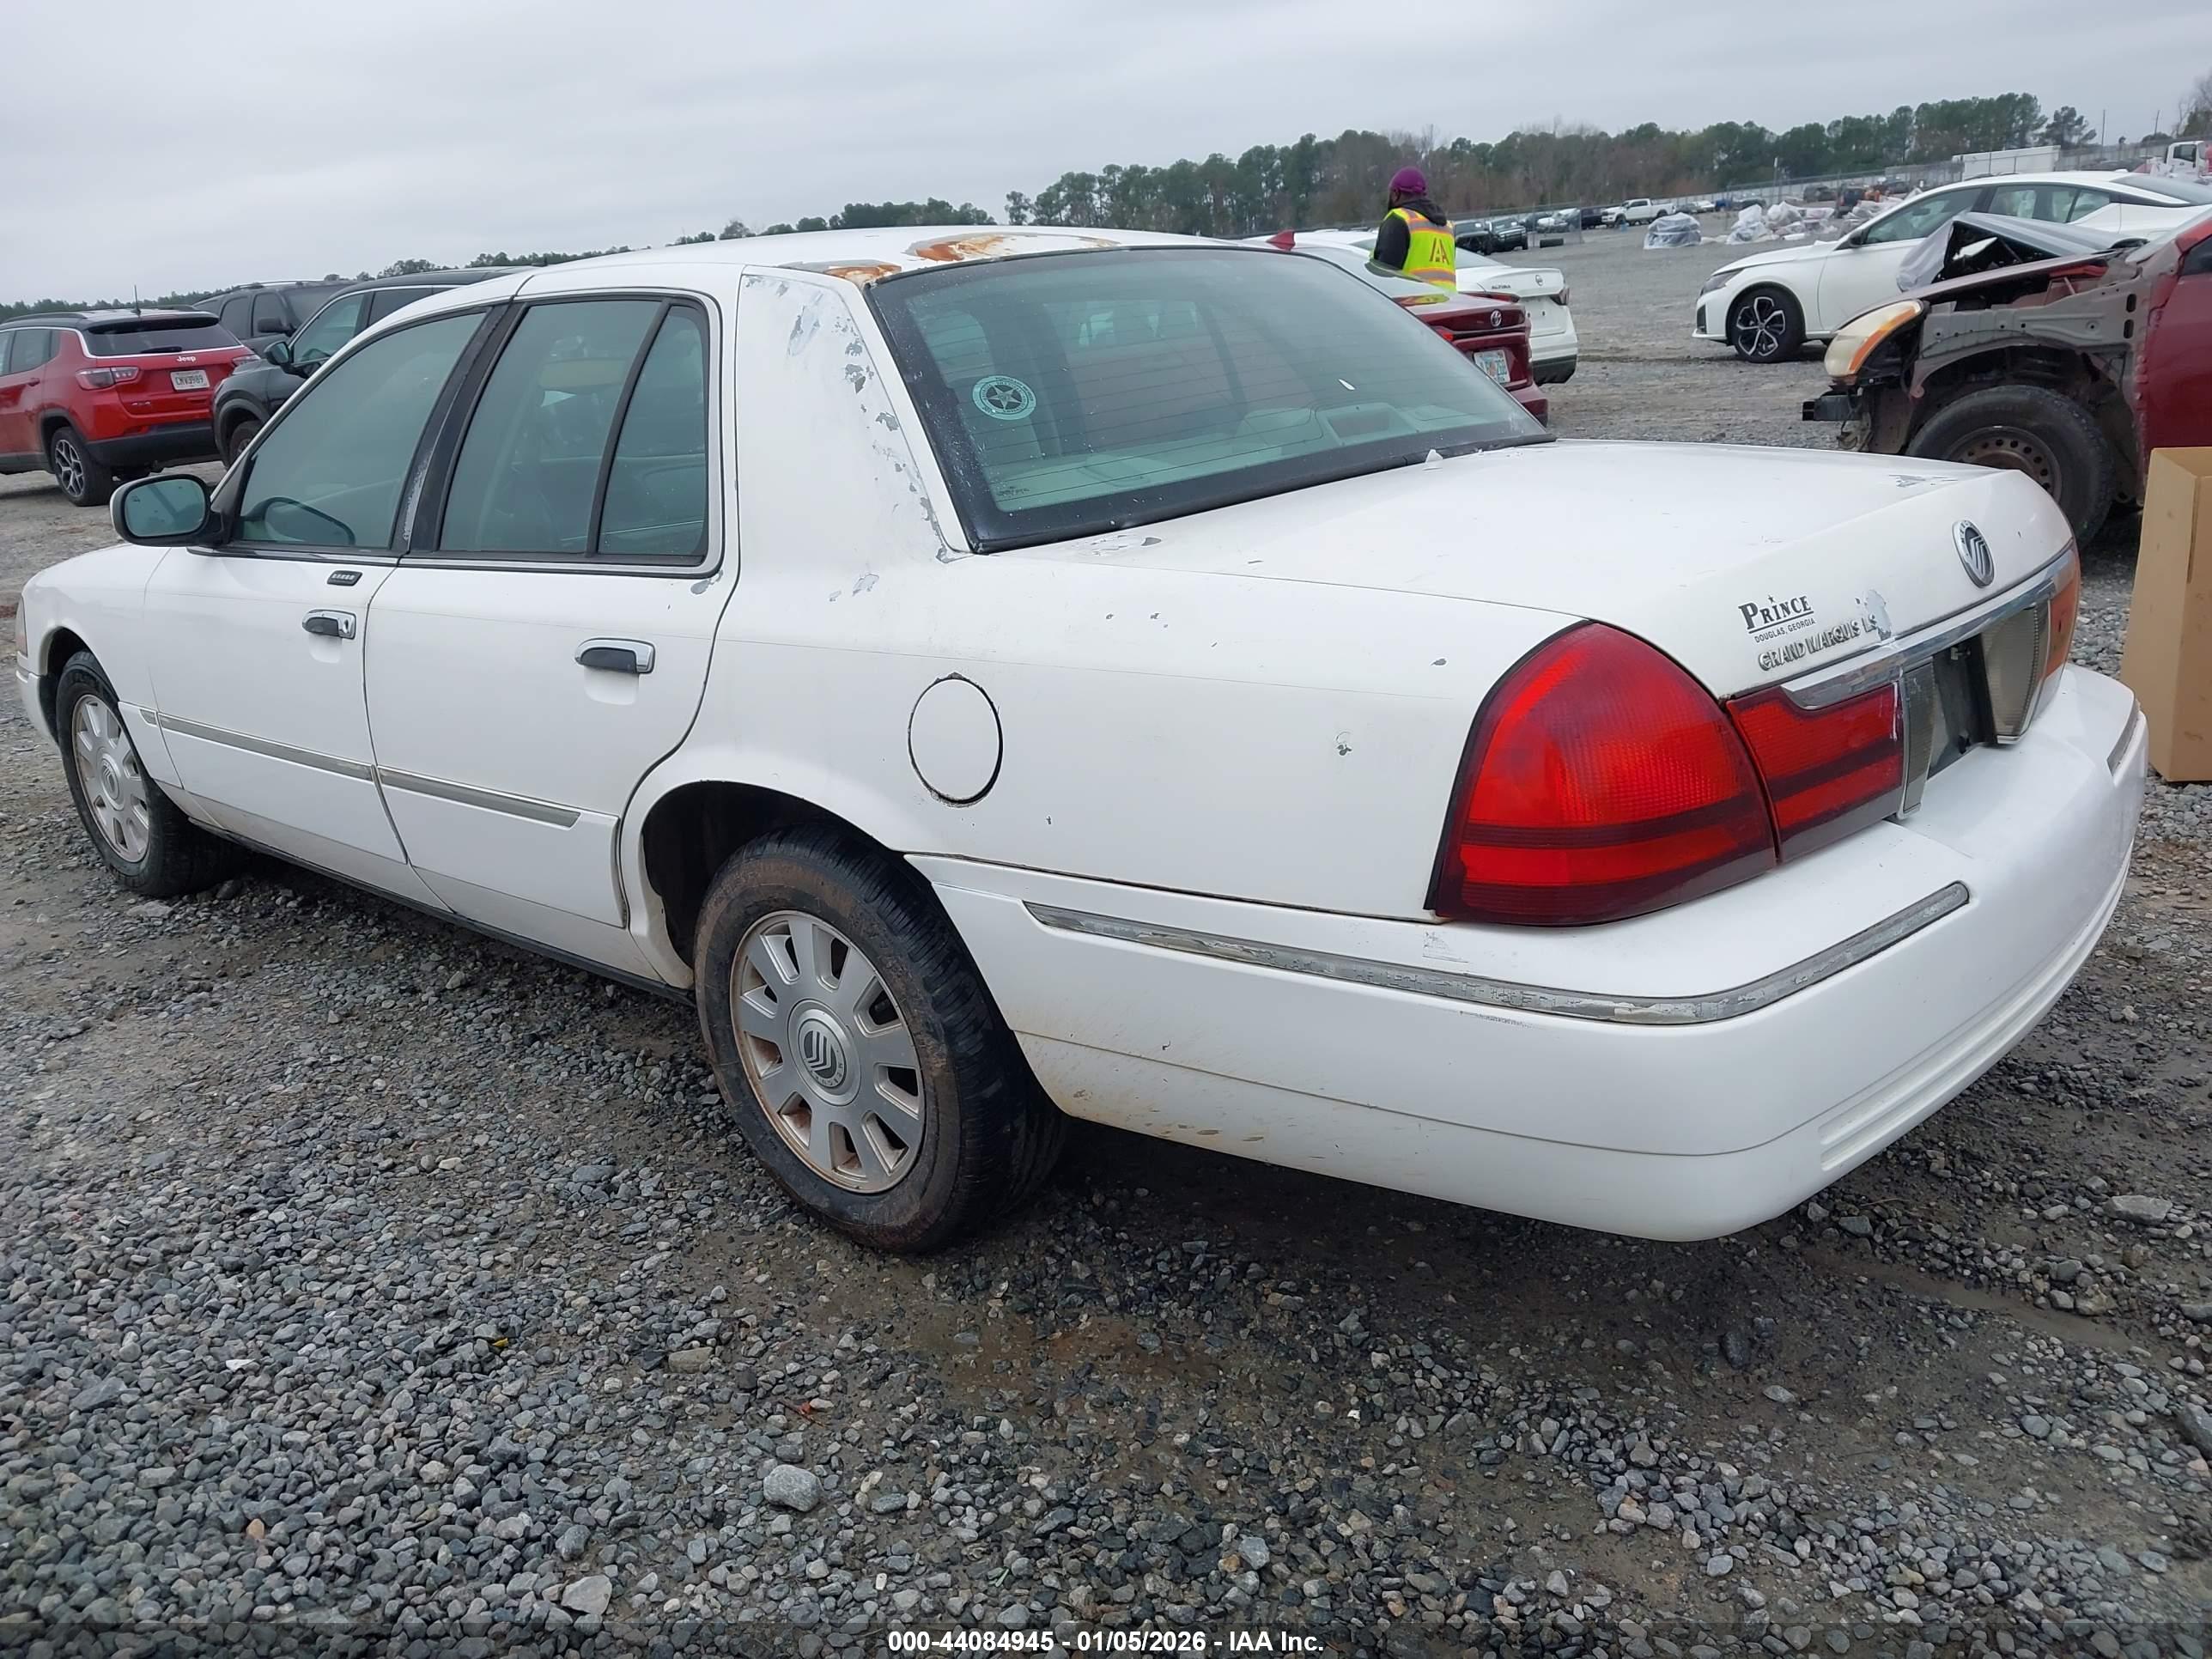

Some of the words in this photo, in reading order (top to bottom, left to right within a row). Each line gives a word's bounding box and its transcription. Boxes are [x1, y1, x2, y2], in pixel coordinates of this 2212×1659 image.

[1754, 627, 1788, 643] DOUGLAS,
[1788, 618, 1816, 632] GEORGIA
[1759, 641, 1806, 671] GRAND
[1805, 620, 1861, 654] MARQUIS
